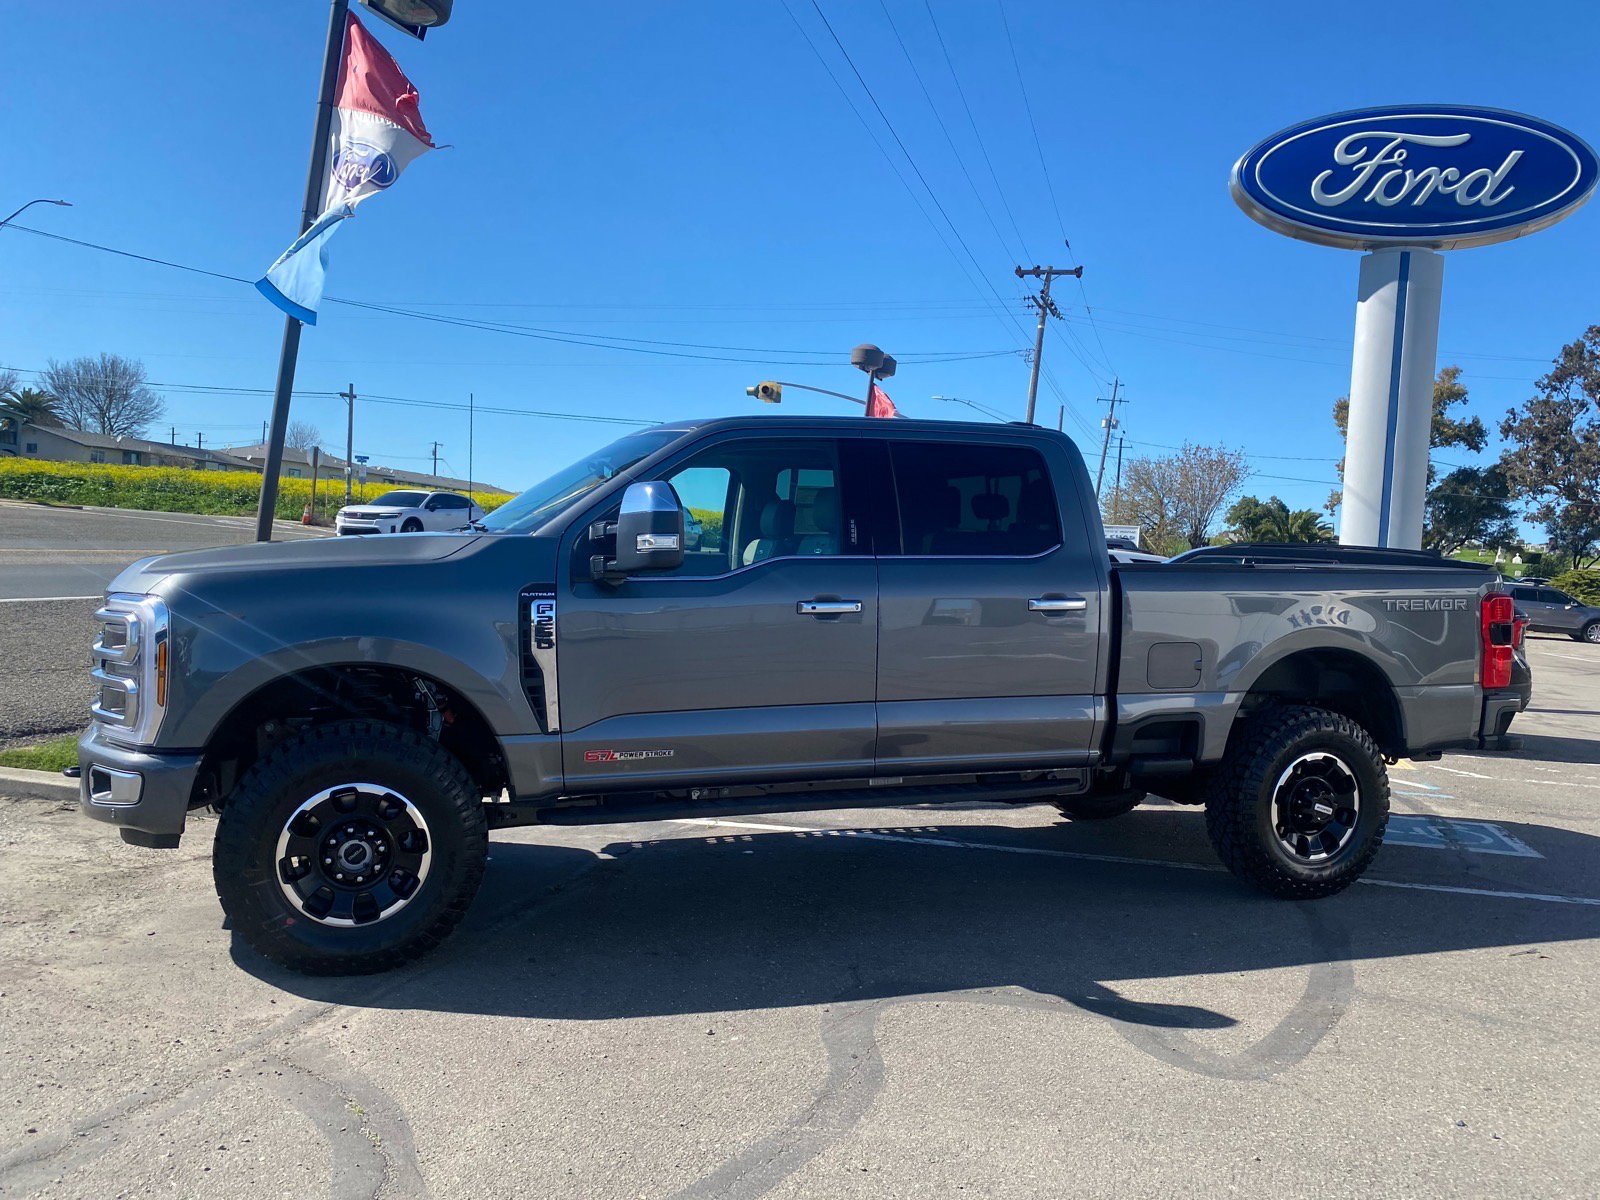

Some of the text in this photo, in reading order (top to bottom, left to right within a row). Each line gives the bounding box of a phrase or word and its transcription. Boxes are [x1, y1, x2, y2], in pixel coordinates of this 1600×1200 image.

[1311, 131, 1524, 206] Ford
[1382, 598, 1469, 612] TREMOR
[619, 751, 644, 759] POWER
[645, 749, 672, 757] STROKE
